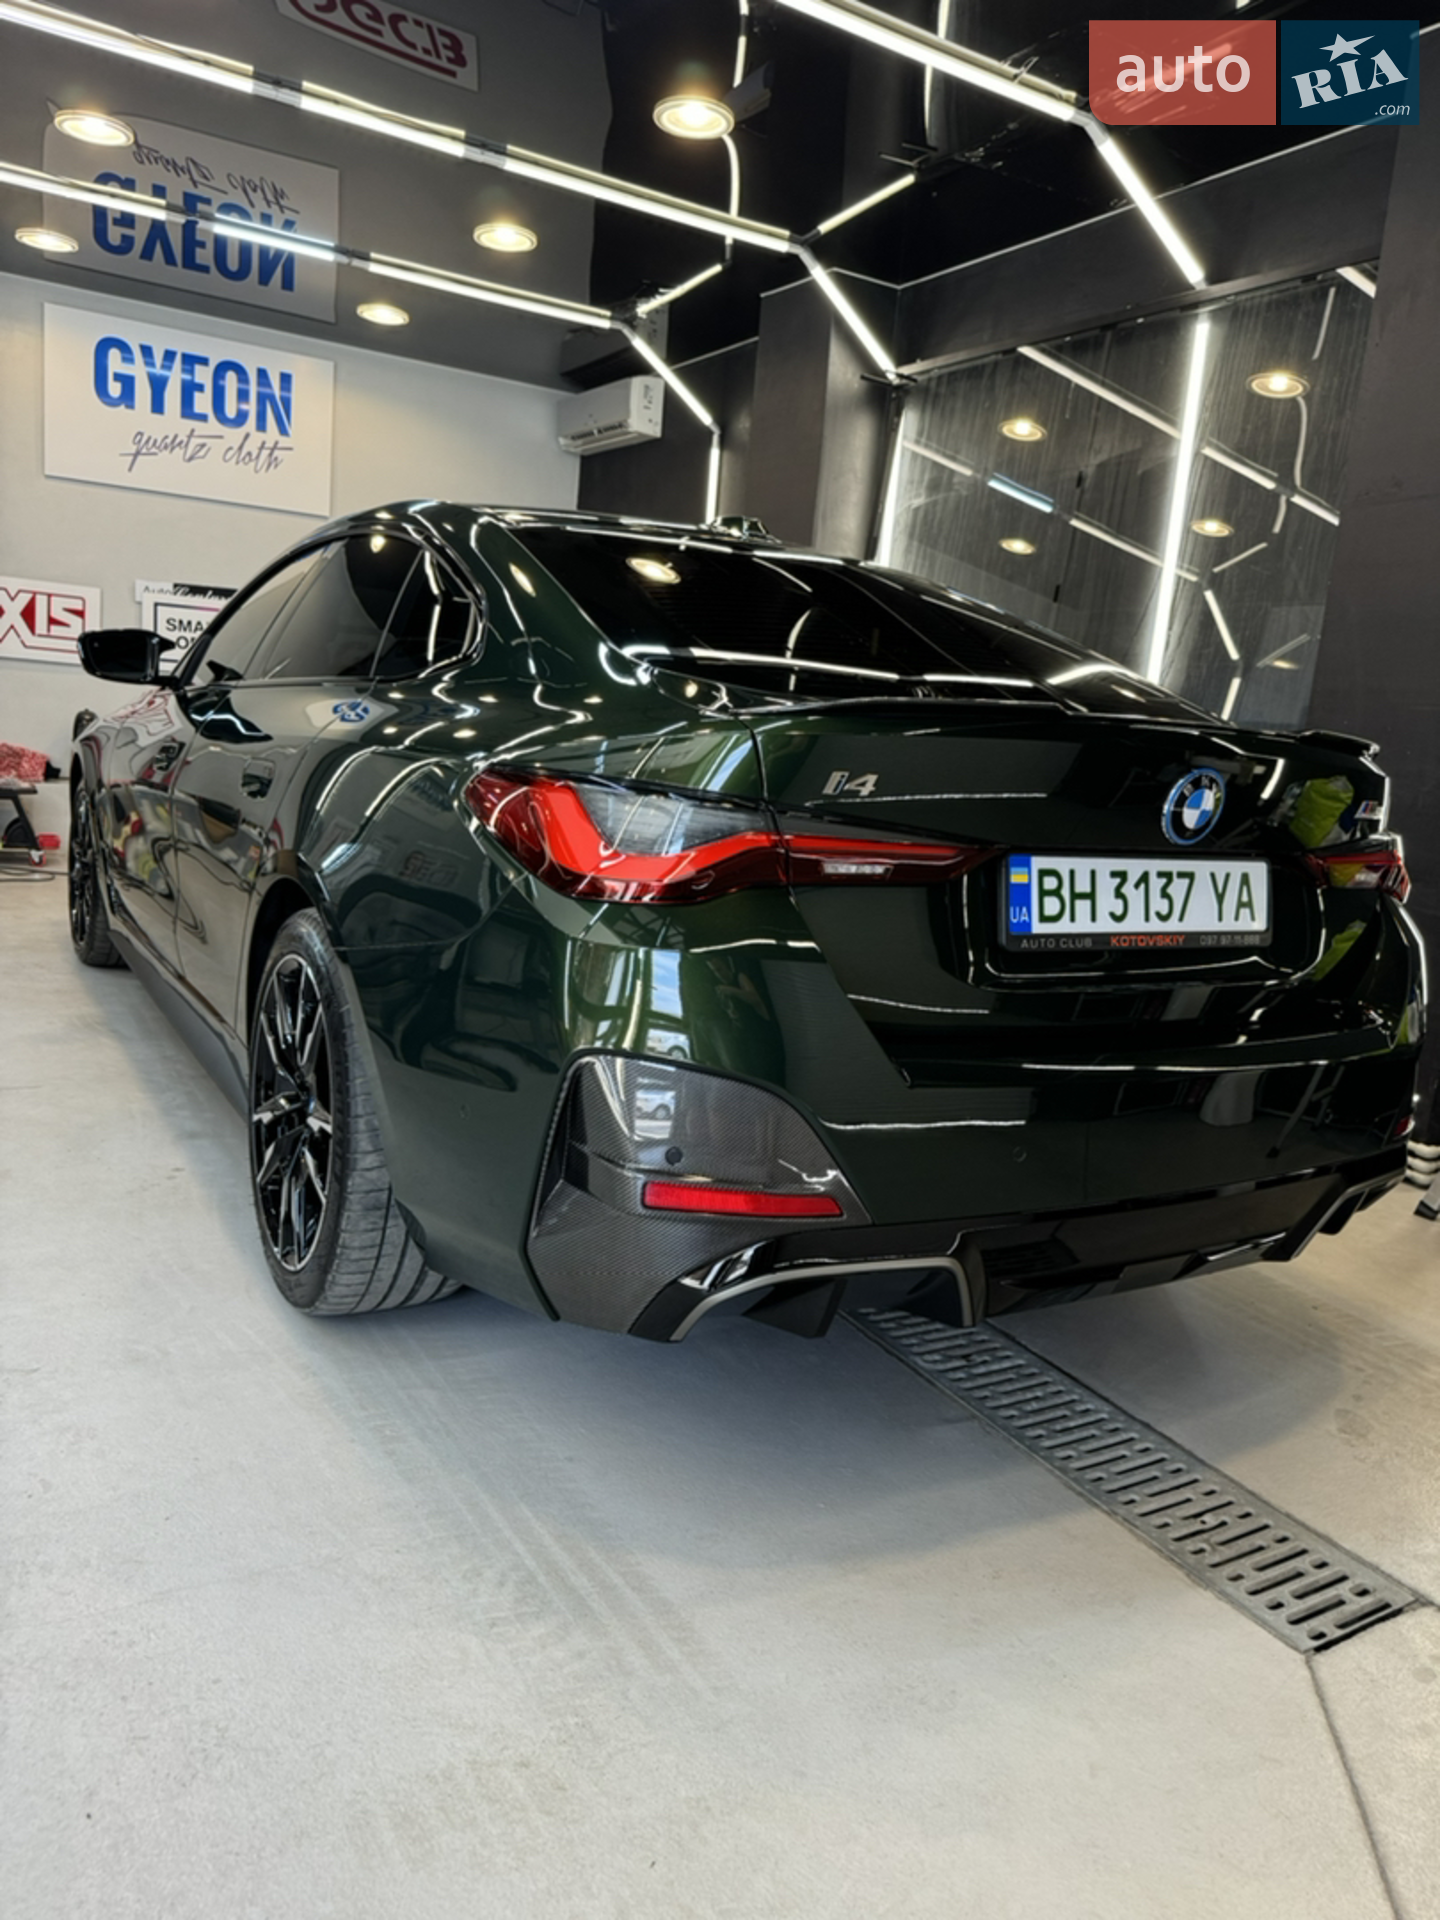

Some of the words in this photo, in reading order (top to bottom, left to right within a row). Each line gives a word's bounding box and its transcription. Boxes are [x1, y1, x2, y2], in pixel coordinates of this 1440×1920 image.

[93, 335, 292, 437] GYEON
[119, 428, 224, 472] quartz
[222, 432, 293, 474] cloth
[166, 618, 209, 634] SMA
[822, 771, 879, 797] i4
[1037, 868, 1097, 924] BH
[1108, 869, 1196, 923] 3137
[1210, 871, 1257, 923] YA
[1010, 905, 1030, 923] UA
[1021, 938, 1055, 949] AUTO
[1059, 937, 1093, 948] CLUB
[1110, 934, 1186, 948] KOTOVSKIY
